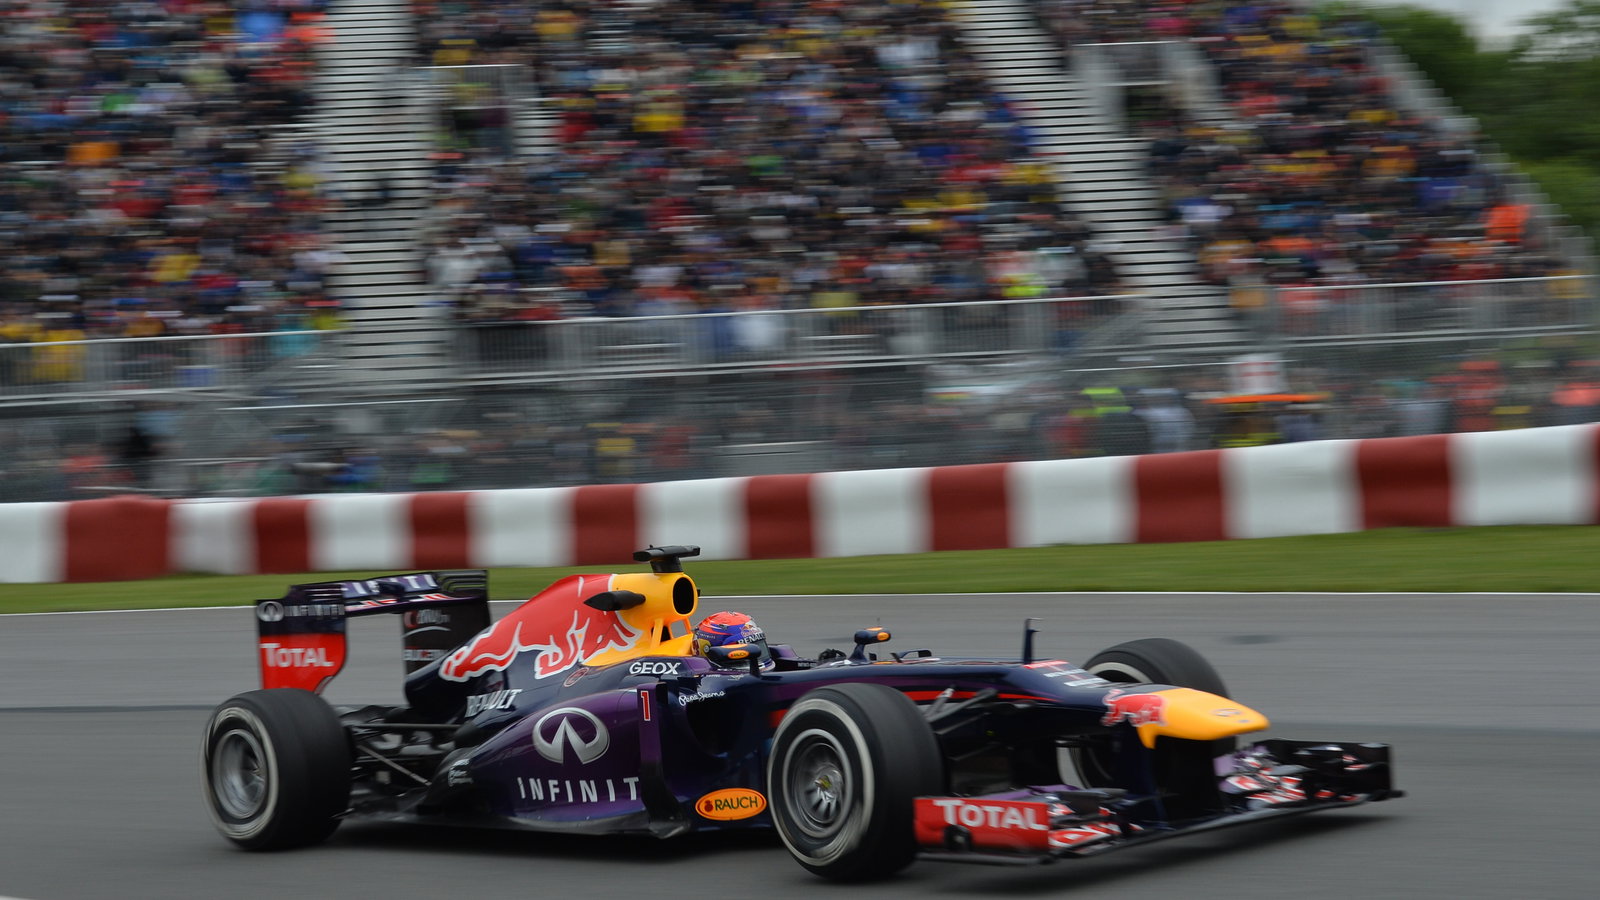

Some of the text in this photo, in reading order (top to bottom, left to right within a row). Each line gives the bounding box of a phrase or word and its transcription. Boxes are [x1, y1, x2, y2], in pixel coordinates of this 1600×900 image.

[261, 643, 334, 667] TOTAL
[629, 662, 681, 675] GEOX
[641, 691, 651, 721] 1
[517, 777, 640, 802] INFINIT
[714, 796, 758, 811] RAUCH
[933, 799, 1049, 830] TOTAL
